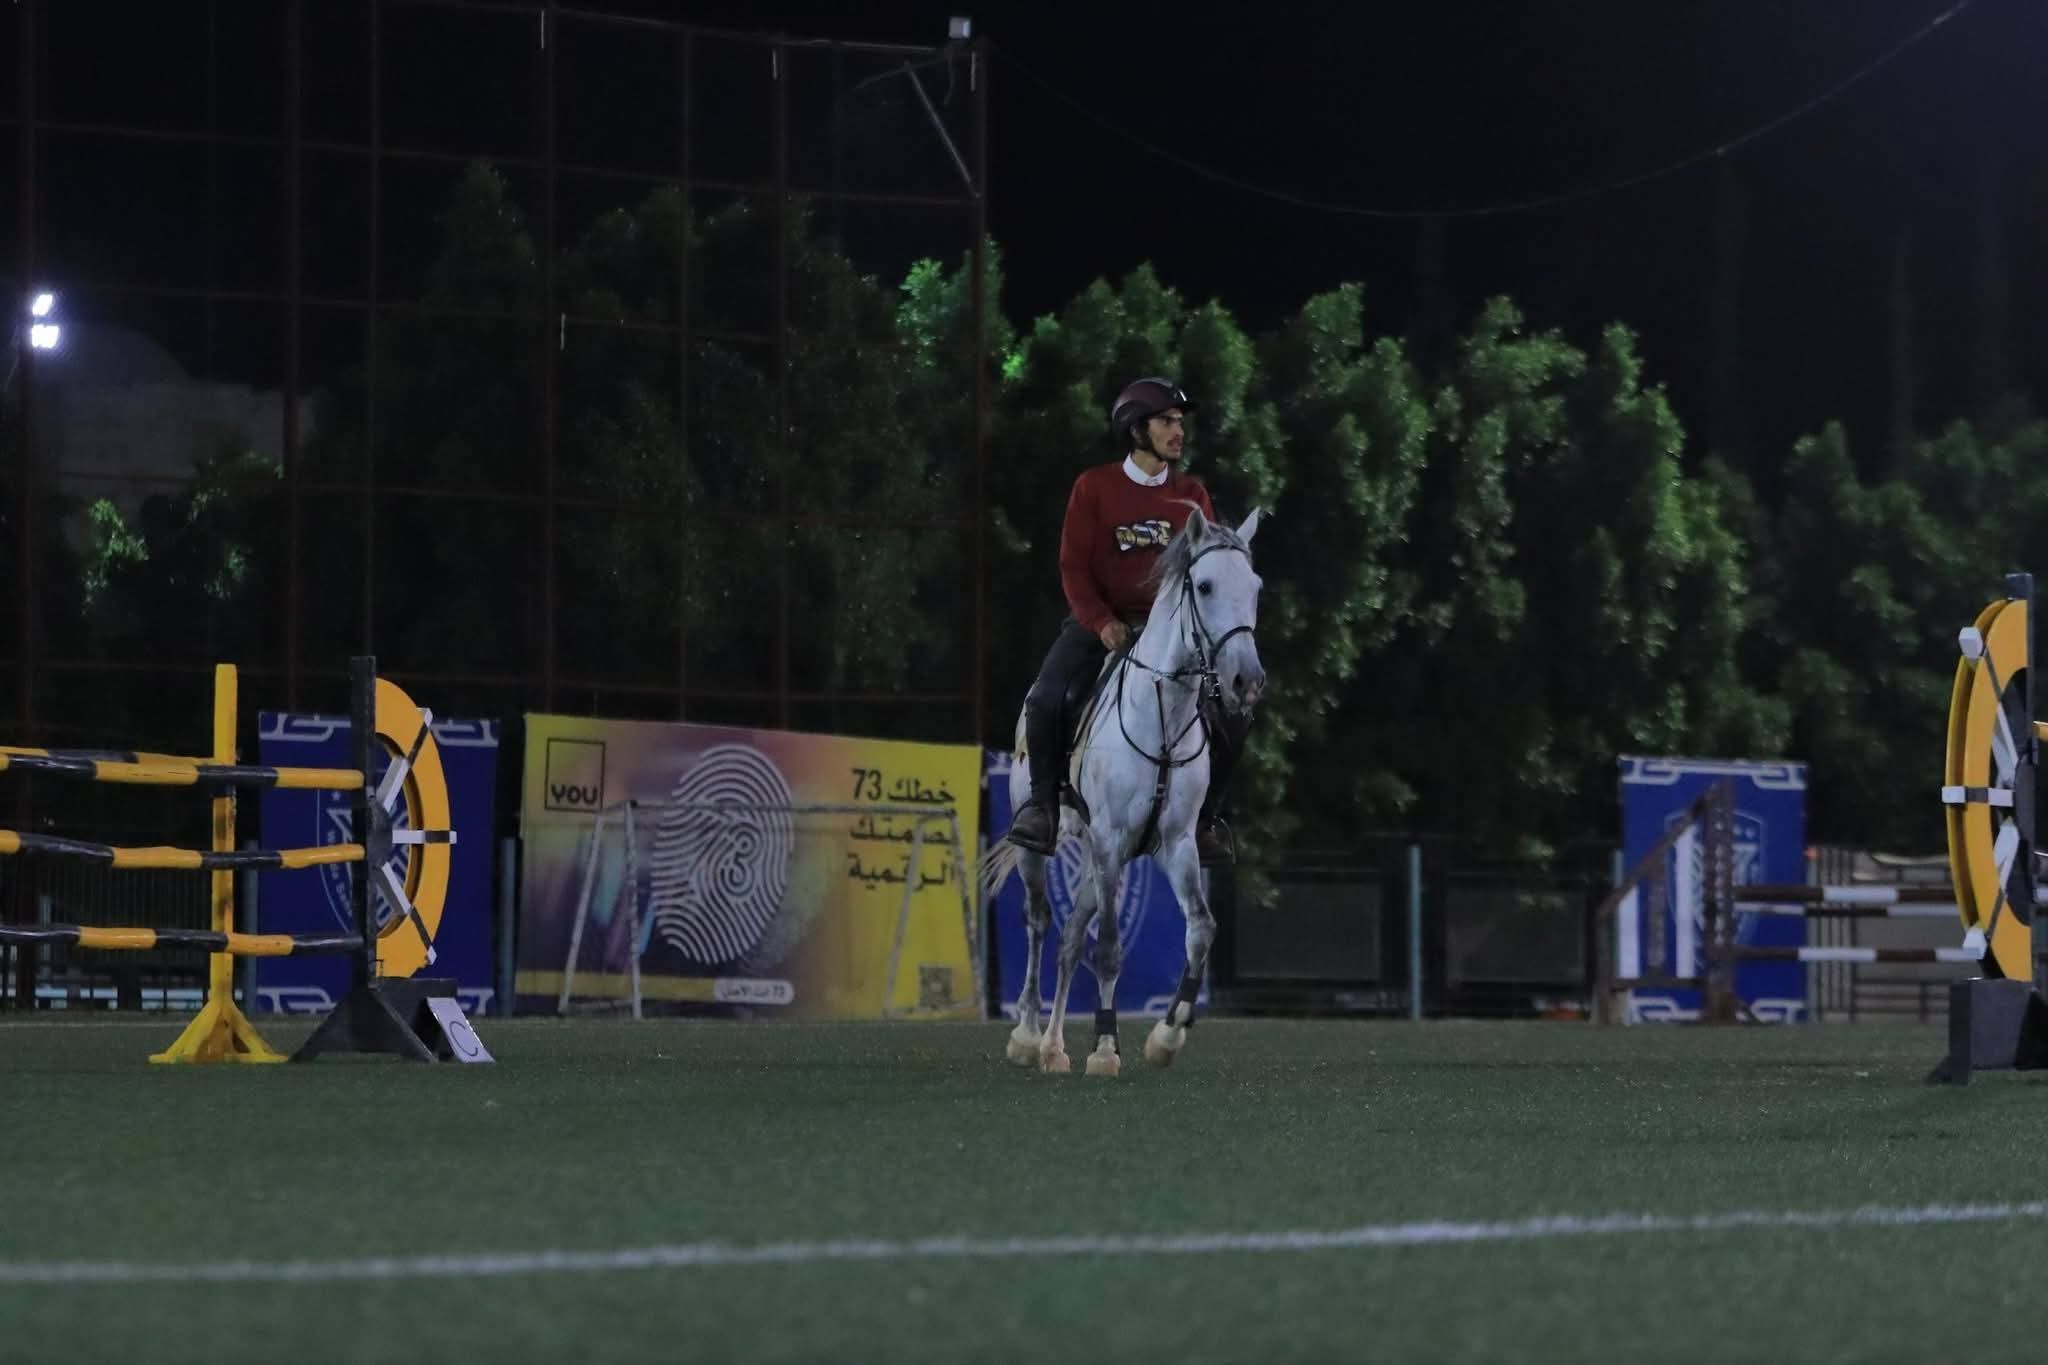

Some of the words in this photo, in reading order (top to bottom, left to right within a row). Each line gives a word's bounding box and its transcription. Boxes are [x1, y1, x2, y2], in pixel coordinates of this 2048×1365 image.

[551, 784, 598, 805] YOU
[852, 768, 882, 801] 73
[888, 779, 956, 804] خطك
